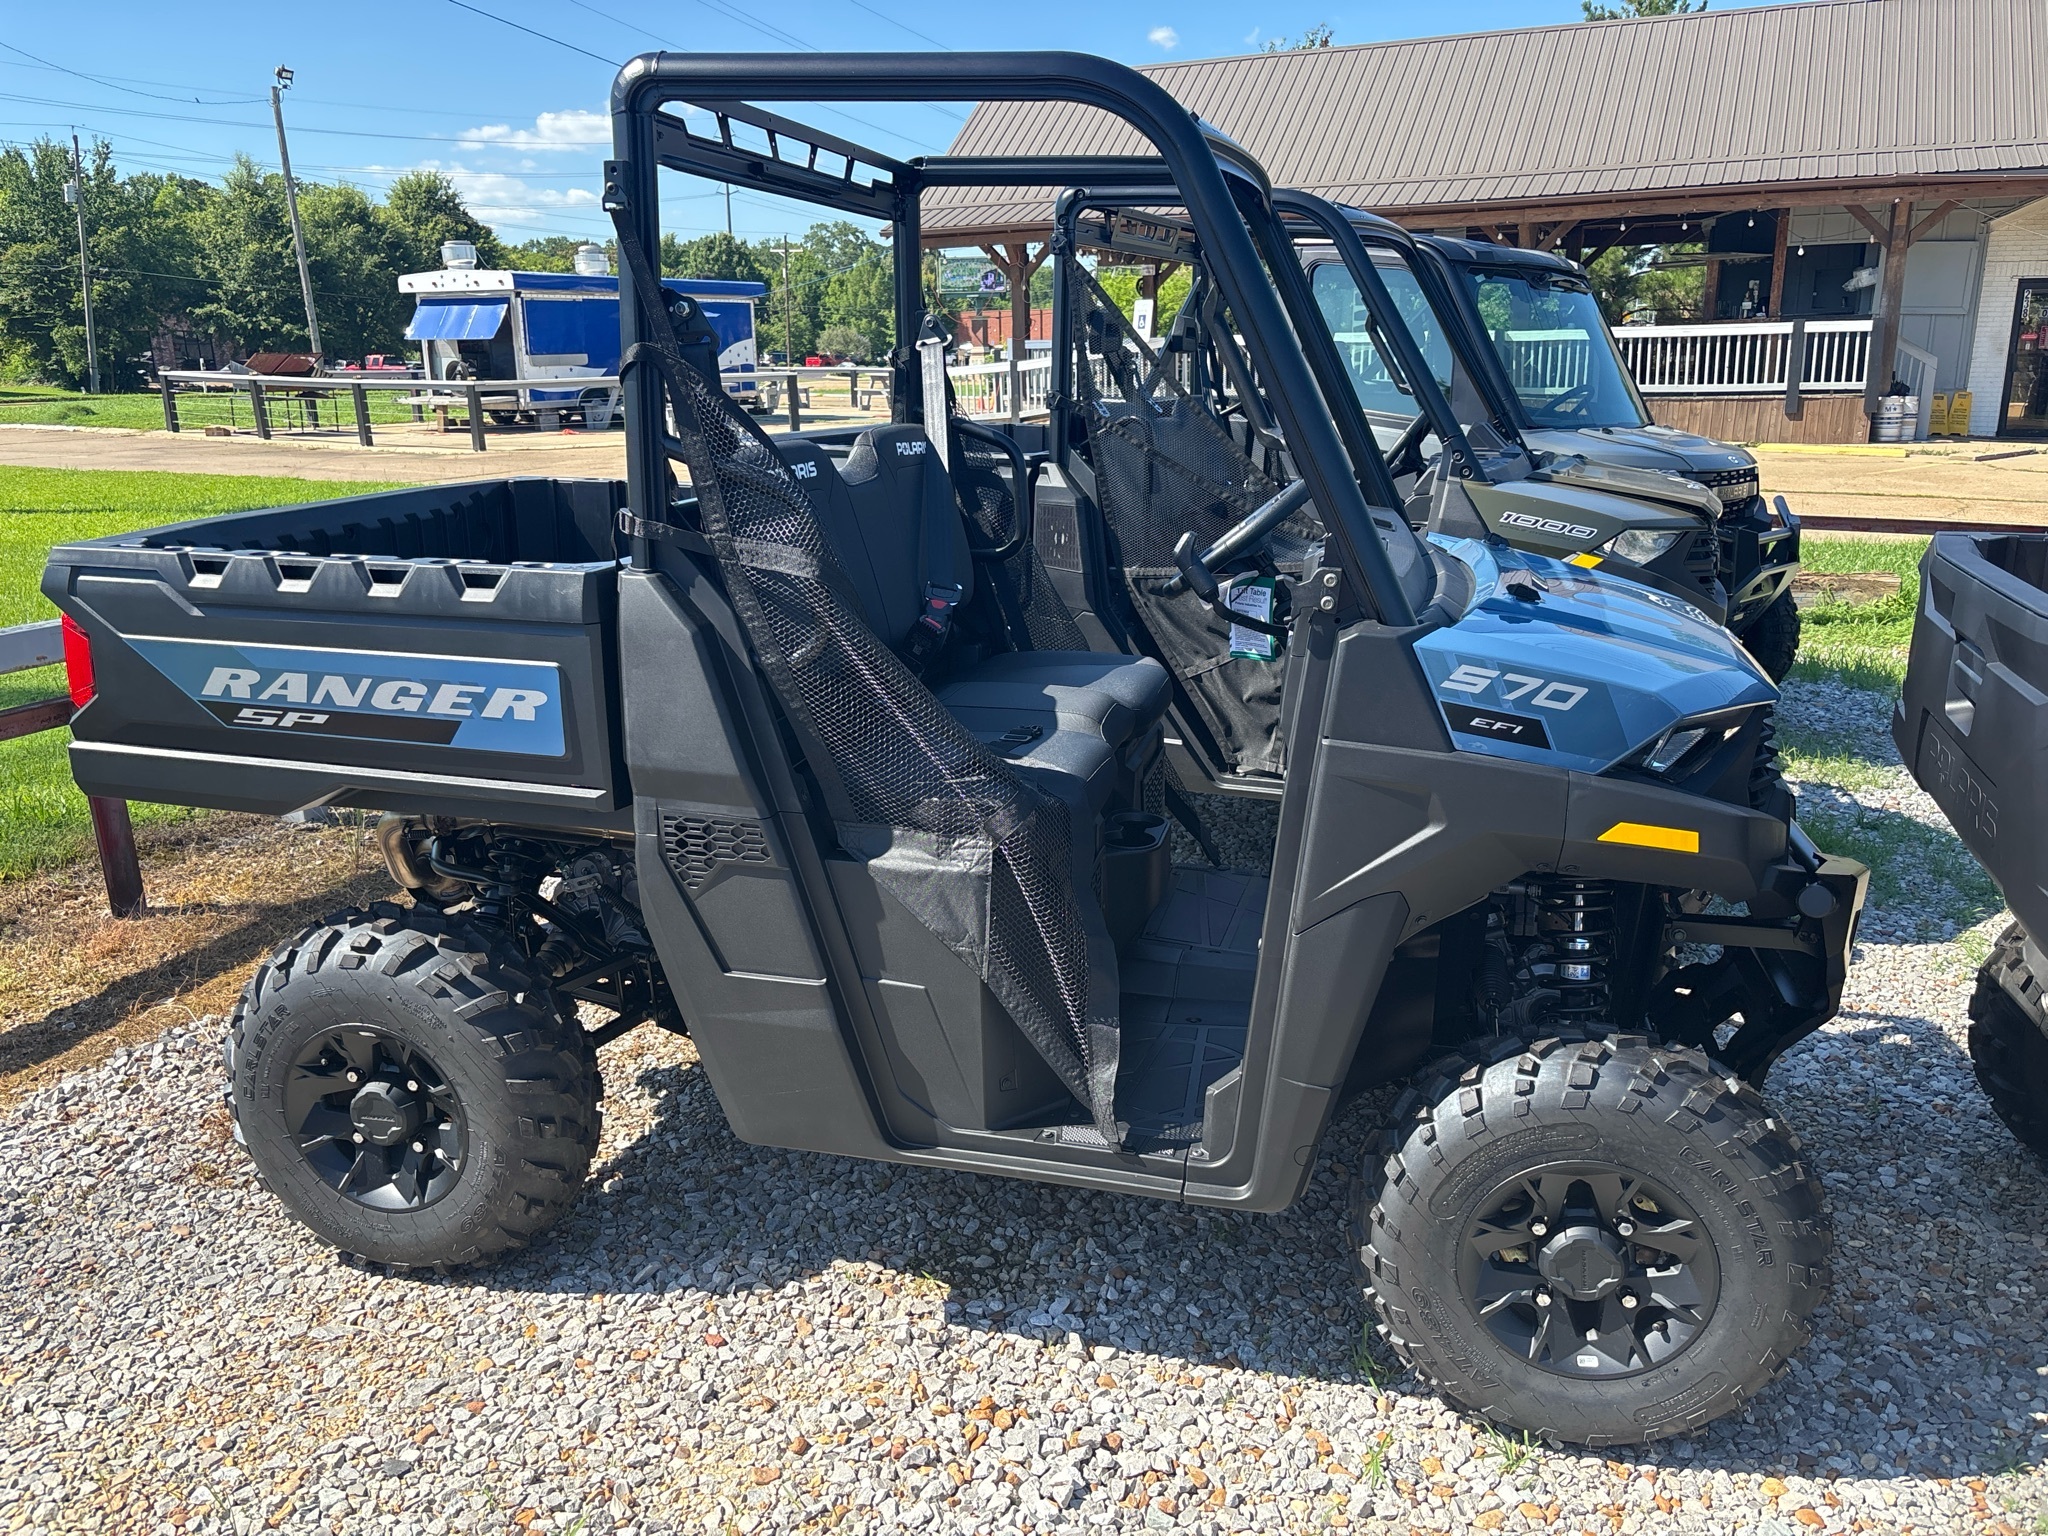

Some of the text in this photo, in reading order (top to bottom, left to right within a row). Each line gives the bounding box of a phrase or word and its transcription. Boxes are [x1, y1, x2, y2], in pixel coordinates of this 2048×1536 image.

[1499, 511, 1598, 539] 1000
[201, 666, 548, 721] RANGER
[1440, 664, 1589, 711] 570
[233, 708, 330, 727] SP
[1469, 717, 1524, 734] EFI
[243, 1003, 291, 1102] CARLSTAR
[1679, 1145, 1775, 1267] CARLSTAR
